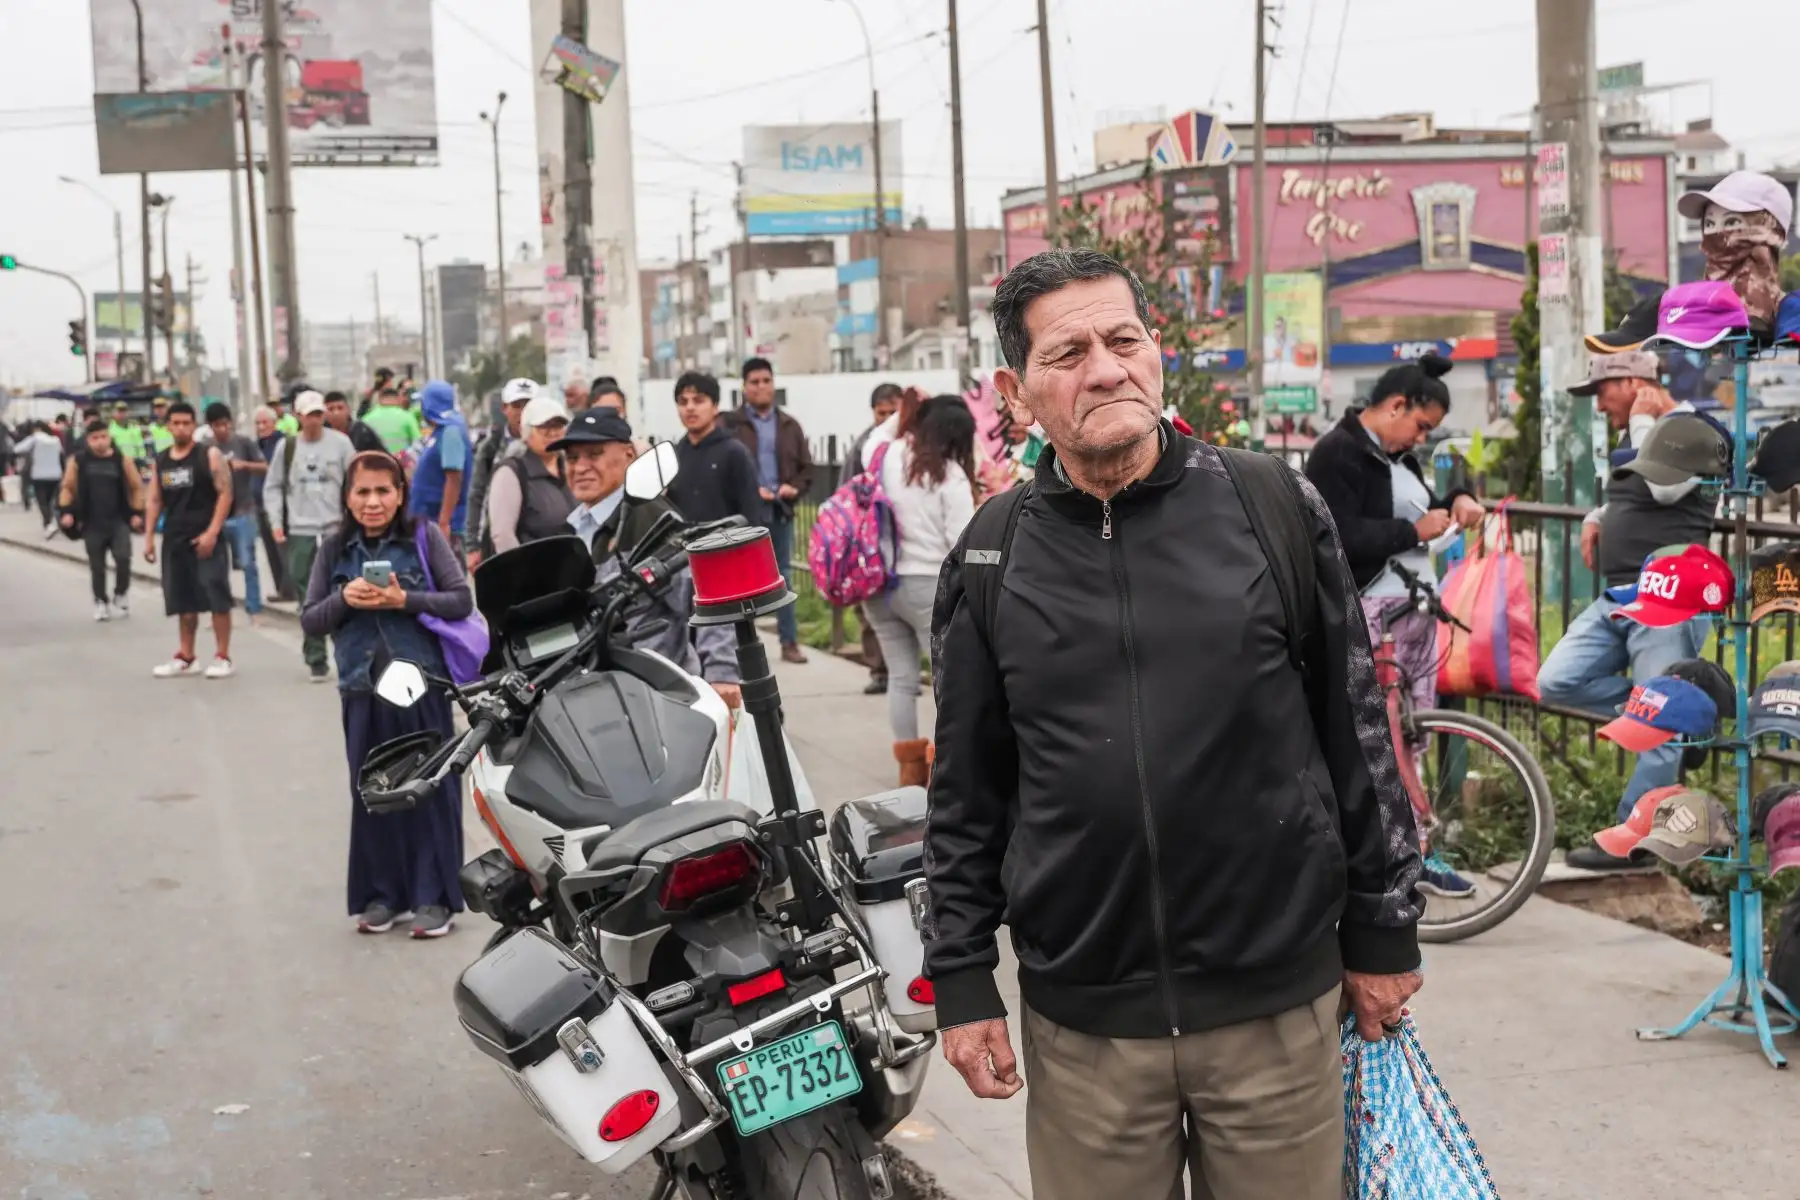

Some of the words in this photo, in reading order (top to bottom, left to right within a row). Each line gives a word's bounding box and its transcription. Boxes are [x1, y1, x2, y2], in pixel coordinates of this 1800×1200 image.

[1638, 570, 1680, 600] ERÚ
[1775, 563, 1799, 592] LA
[756, 1038, 805, 1069] PERU
[733, 1046, 849, 1118] EP-7332
